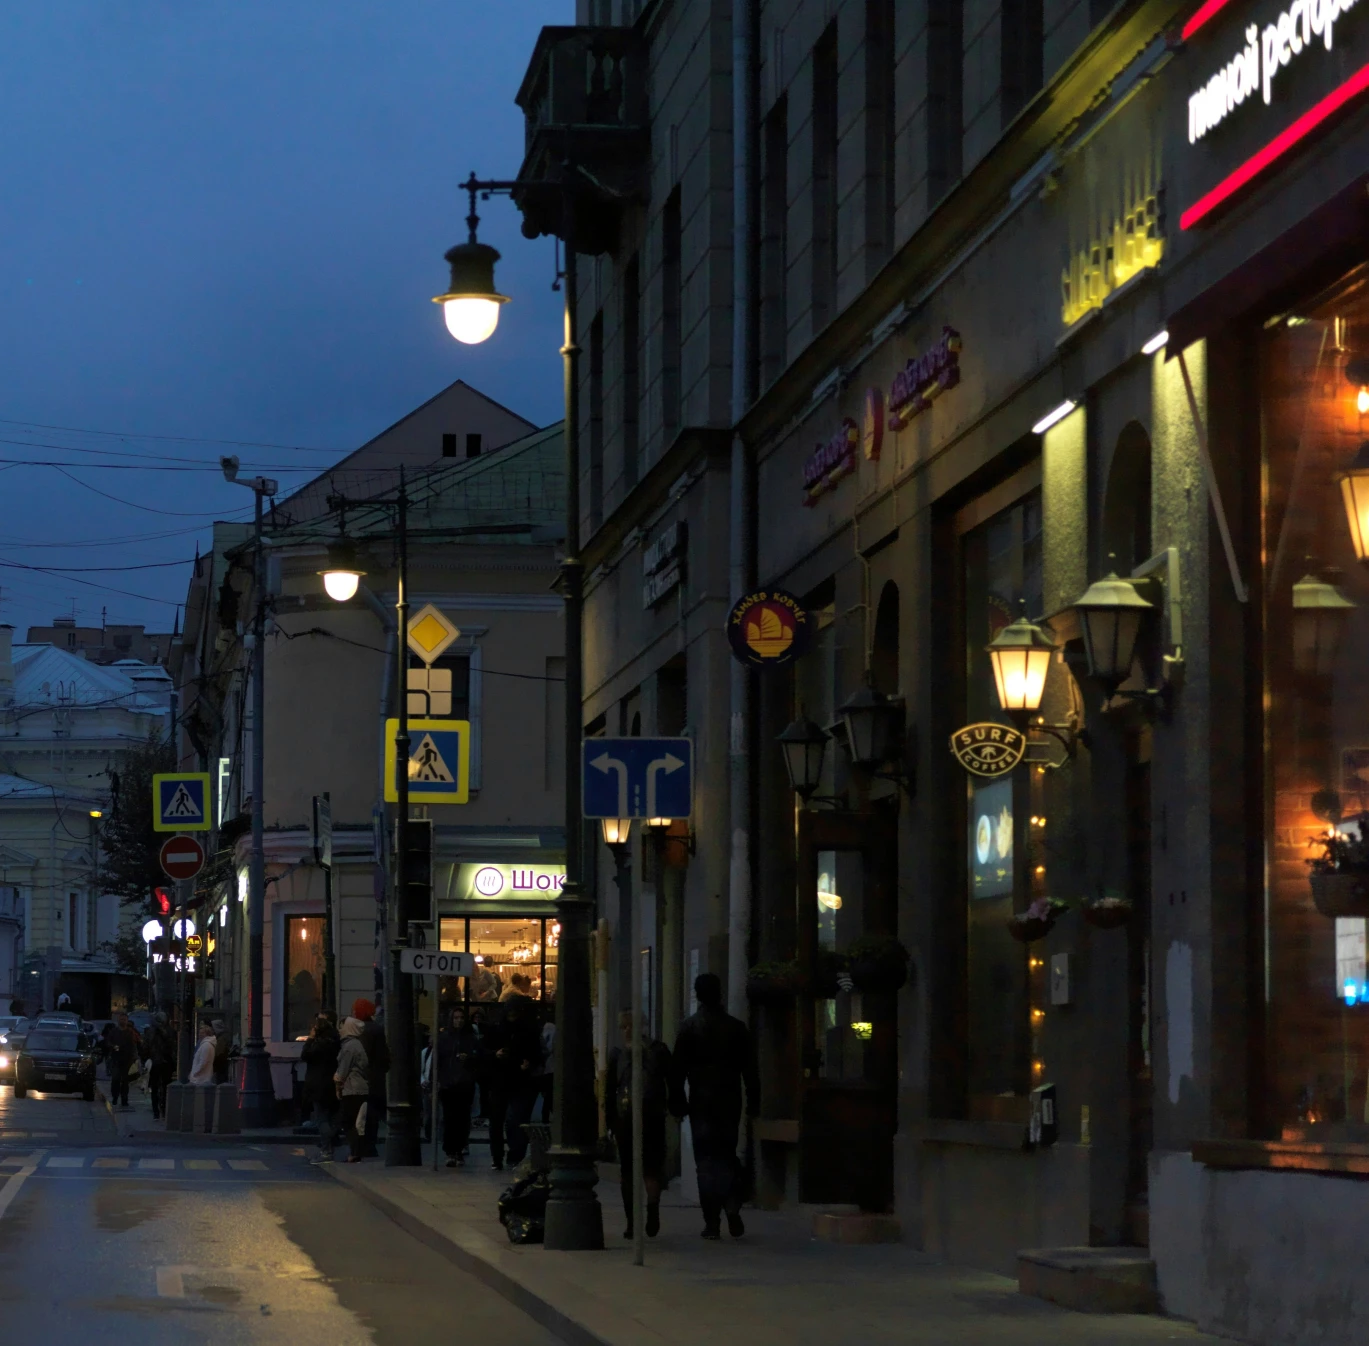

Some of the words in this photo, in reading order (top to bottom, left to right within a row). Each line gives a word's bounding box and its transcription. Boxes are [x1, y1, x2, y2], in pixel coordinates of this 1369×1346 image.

[961, 728, 1017, 745] SURF
[964, 752, 1015, 772] COFFEE
[513, 870, 567, 890] Шок
[413, 954, 461, 972] СТОП
